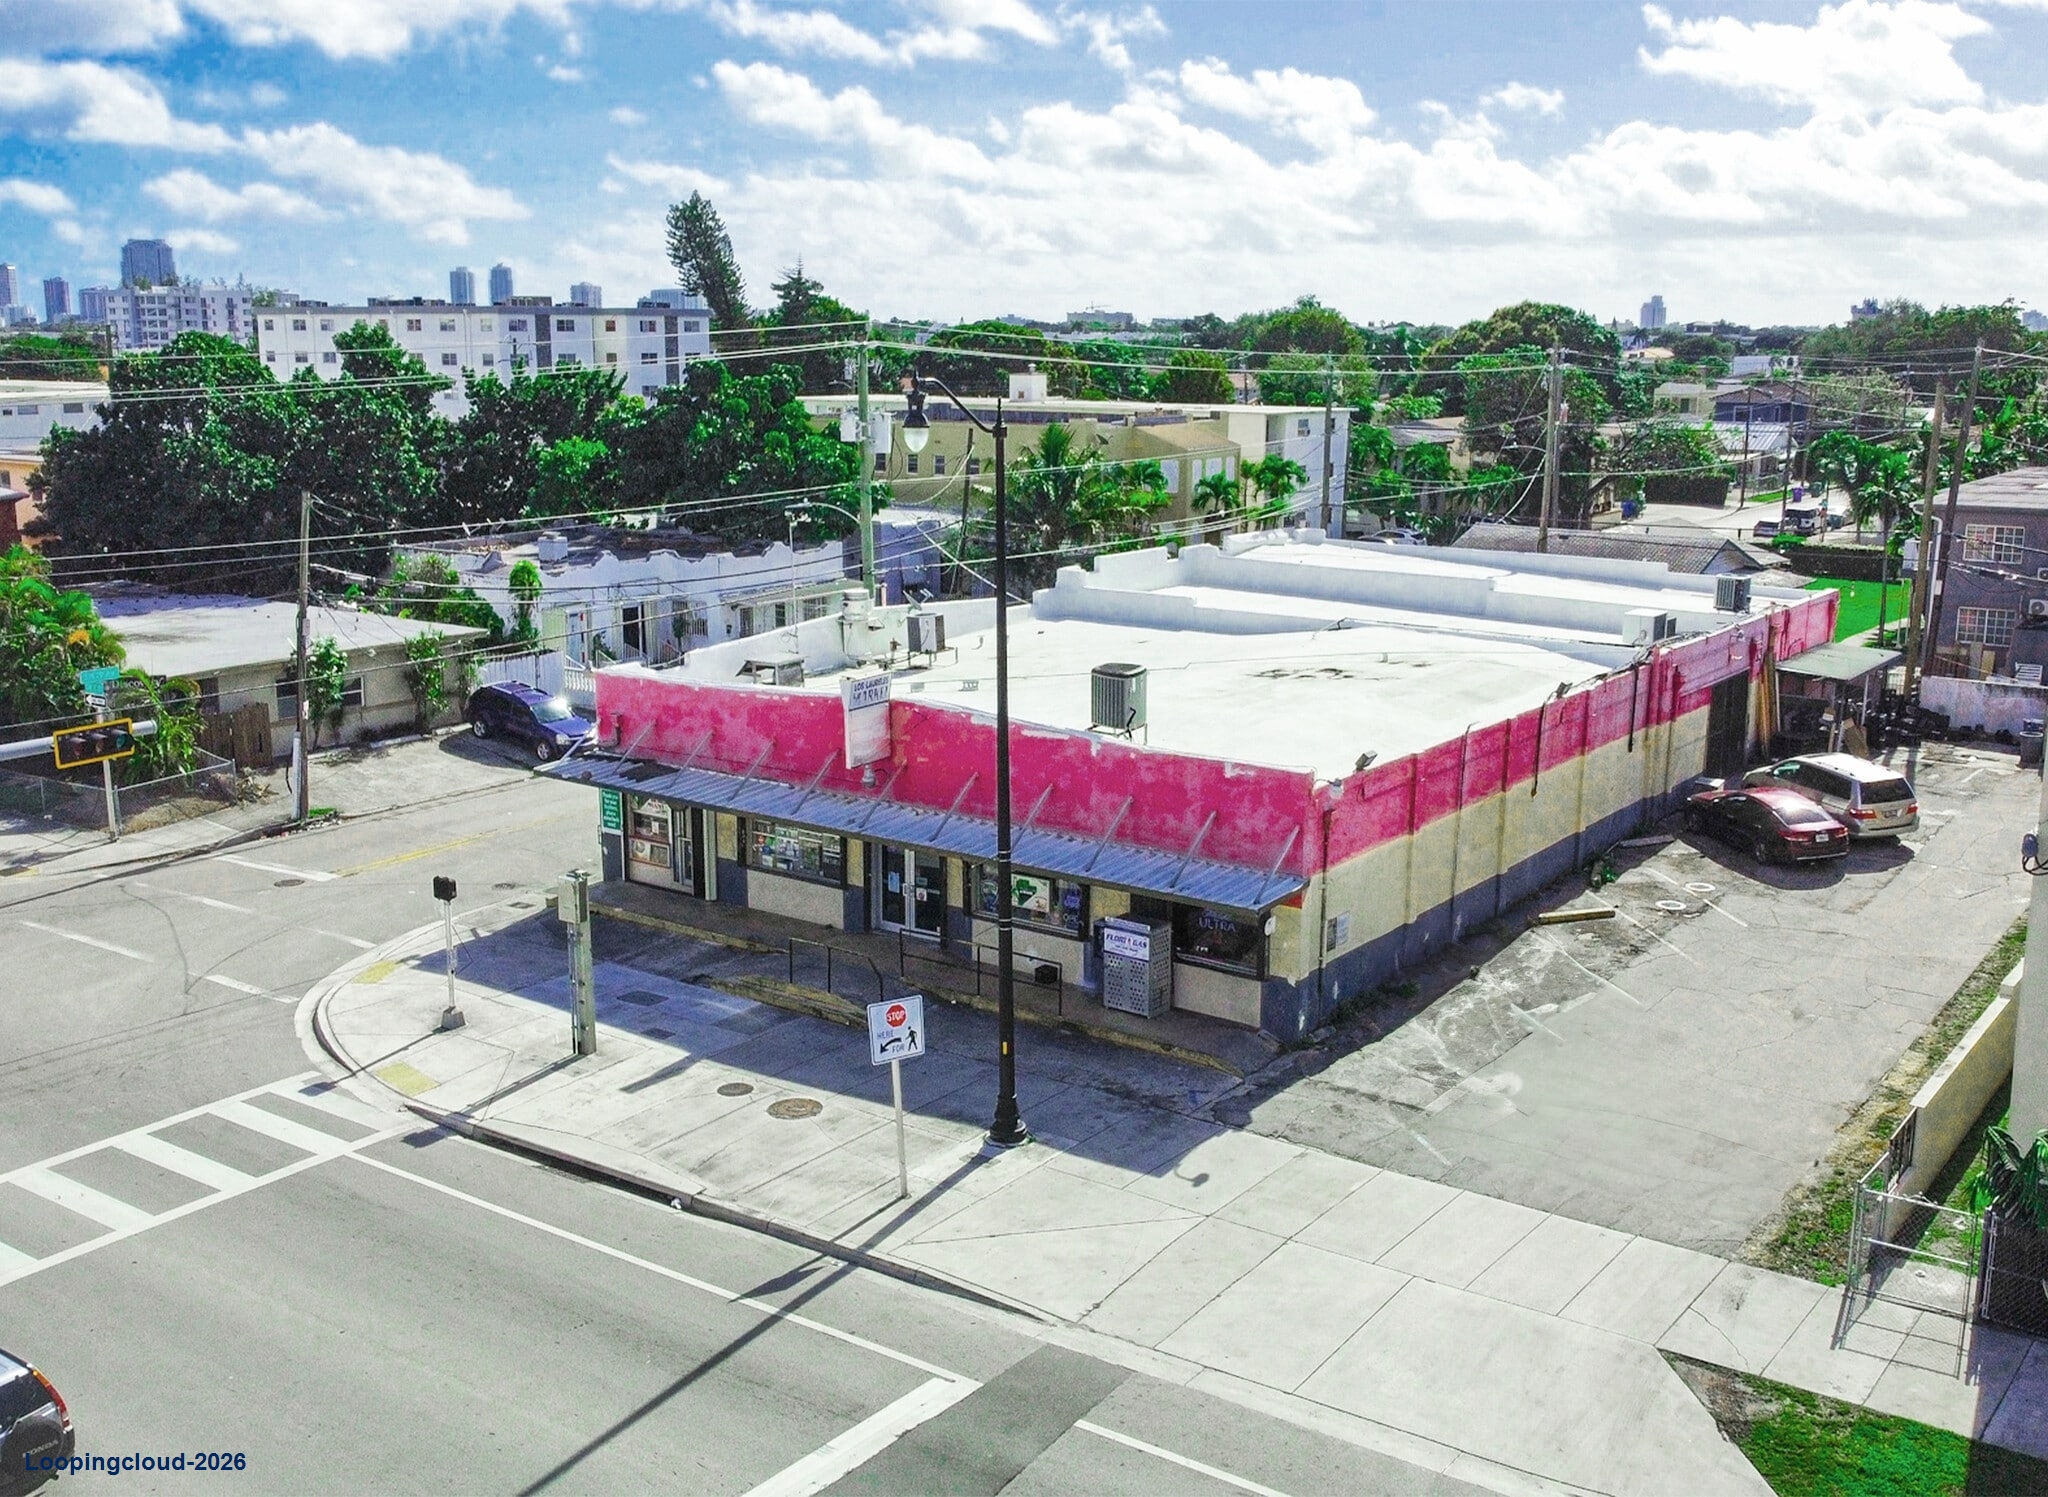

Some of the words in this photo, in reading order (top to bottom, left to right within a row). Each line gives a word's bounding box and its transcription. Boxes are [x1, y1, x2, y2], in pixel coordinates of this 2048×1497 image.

[886, 1010, 905, 1022] STOP
[876, 1030, 894, 1040] HERE
[891, 1043, 905, 1054] FOR
